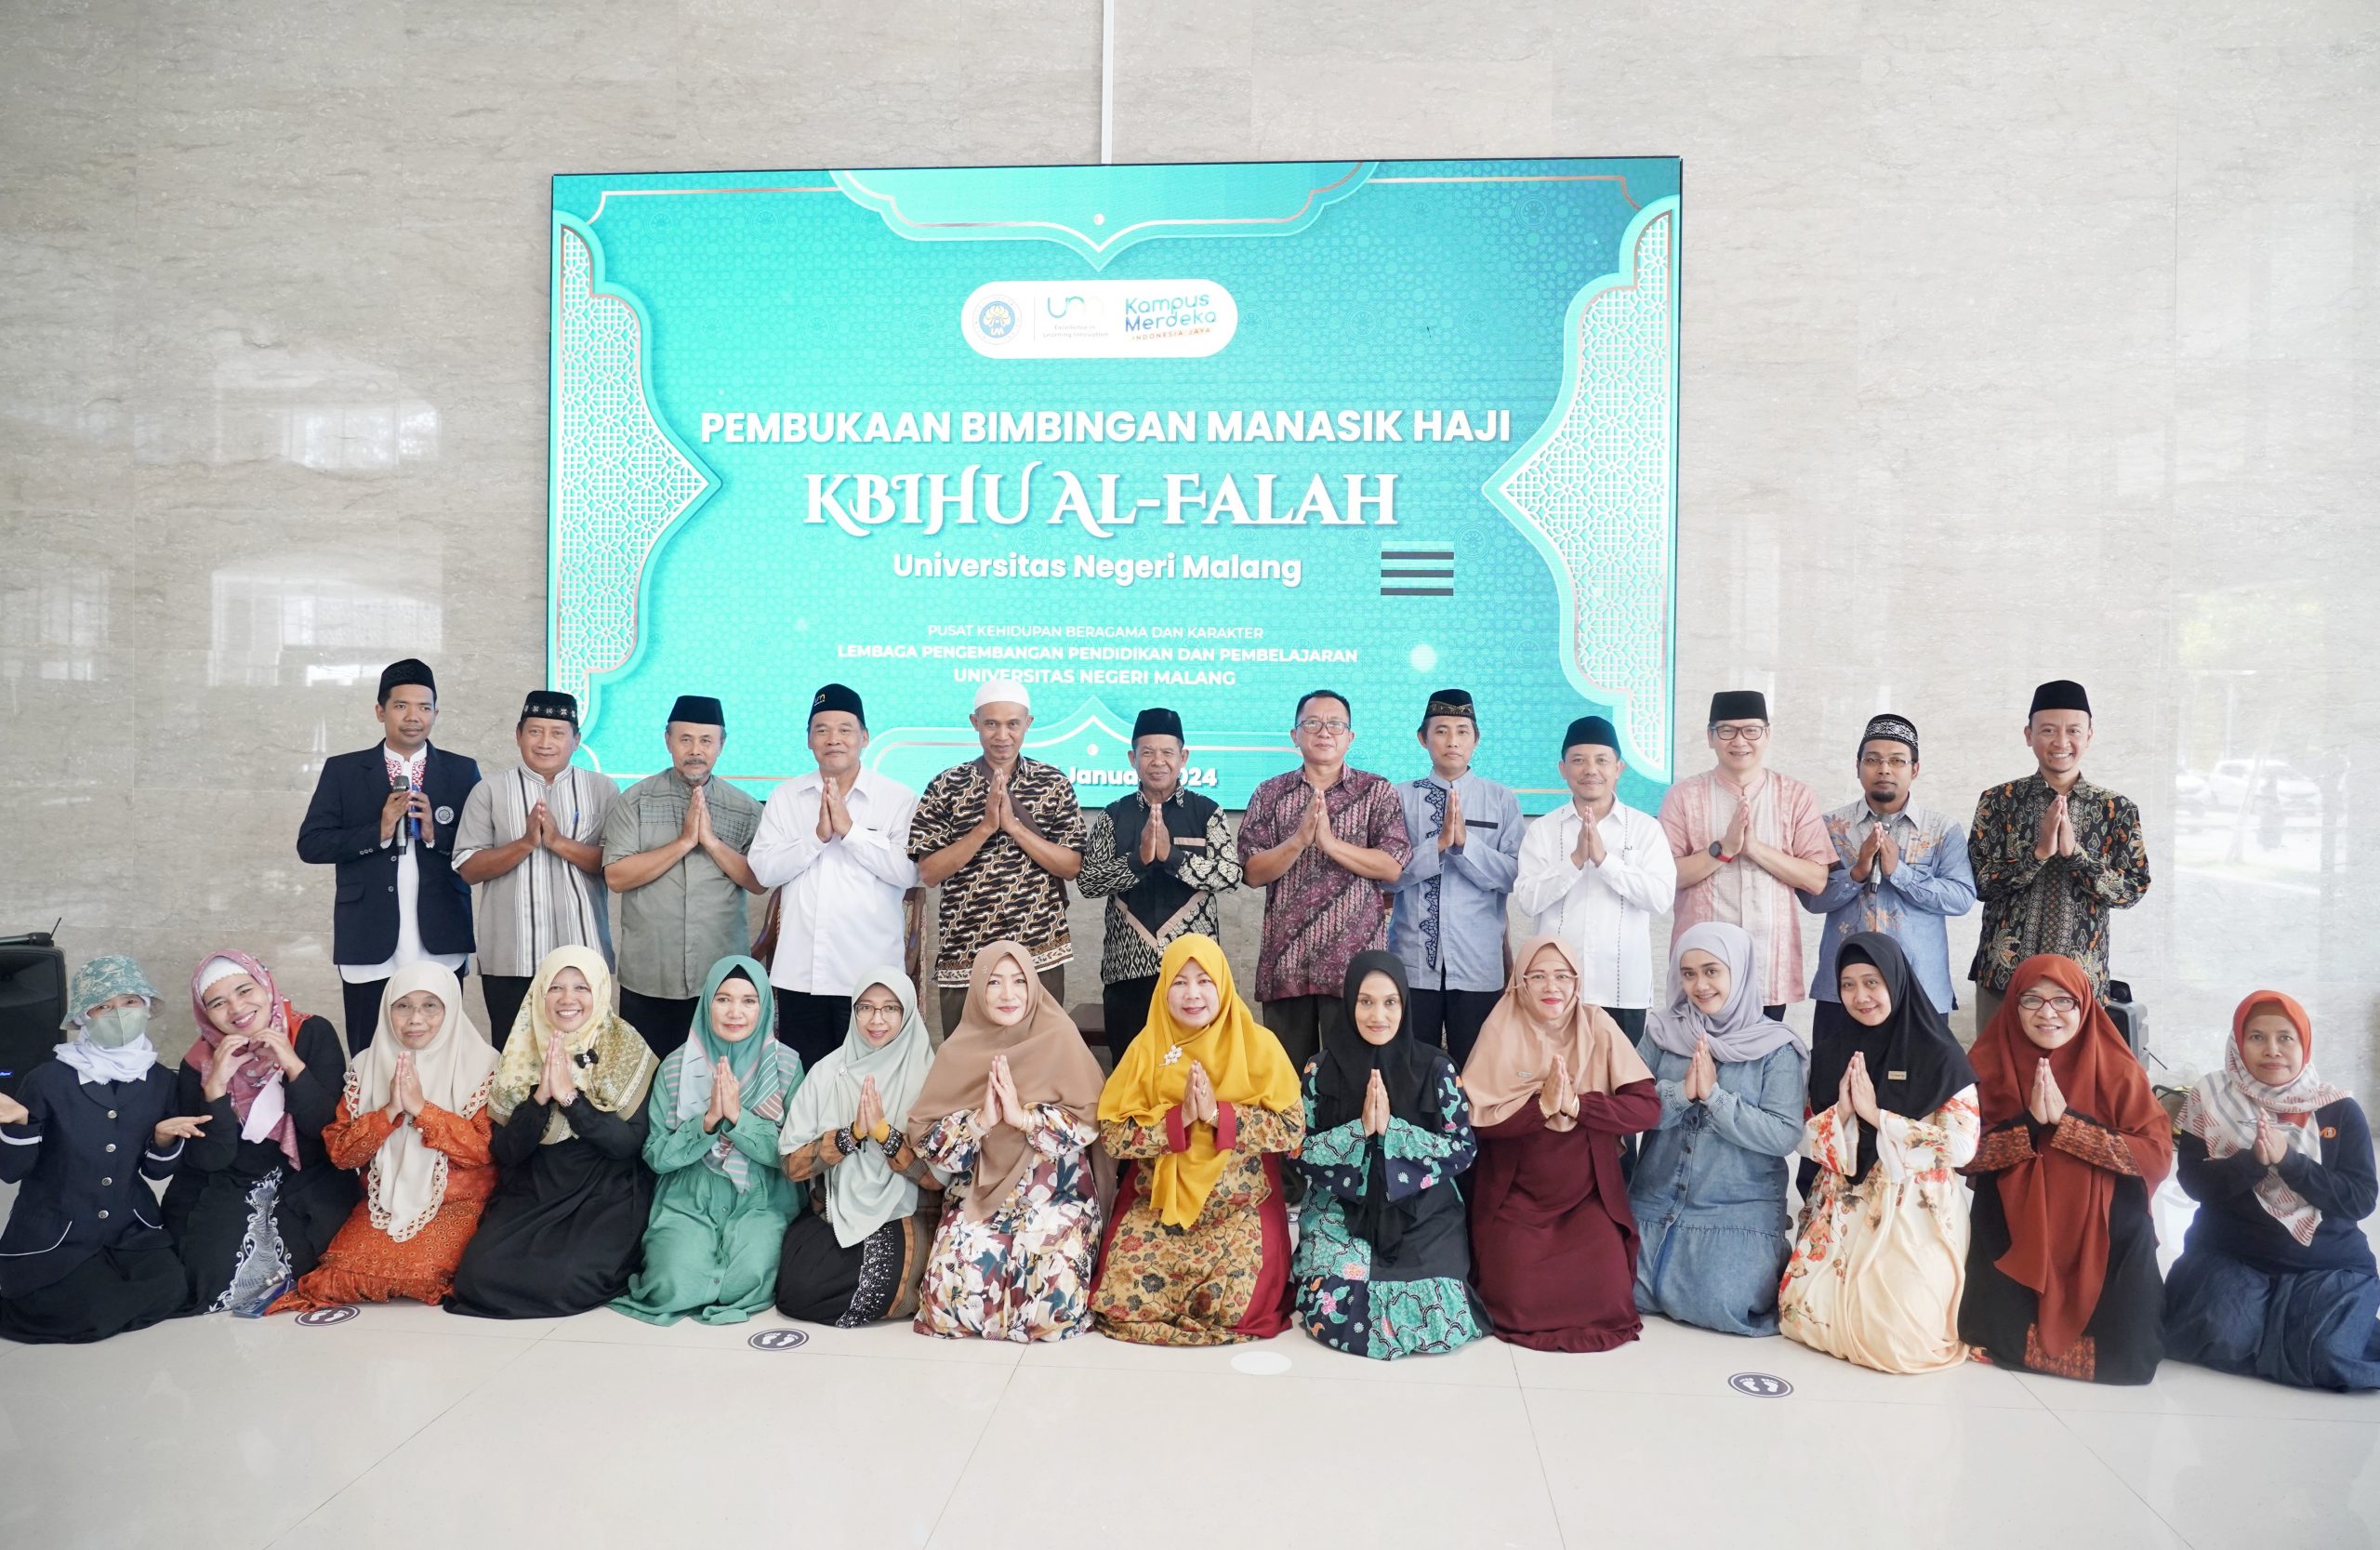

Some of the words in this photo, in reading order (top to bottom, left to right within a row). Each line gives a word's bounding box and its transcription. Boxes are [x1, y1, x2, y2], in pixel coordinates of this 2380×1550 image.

[1125, 294, 1210, 315] Kampus
[1125, 309, 1217, 332] Merdeka
[1132, 330, 1183, 340] INDONESIA
[1188, 327, 1210, 336] JAYA
[701, 412, 951, 443] PEMBUKAAN
[961, 411, 1197, 443] BIMBINGAN
[1208, 410, 1402, 442] MANASIK
[1413, 410, 1511, 442] HAJI
[803, 460, 1043, 537] KBIHU
[1047, 469, 1398, 538] AL-FALAH
[893, 551, 1066, 578] Universitas
[1075, 551, 1175, 586] Negeri
[1183, 553, 1302, 587] Malang
[928, 624, 973, 637] PUSAT
[977, 625, 1062, 638] KEHIDUPAN
[1065, 626, 1146, 638] BERAGAMA
[1152, 627, 1183, 638] DAN
[1187, 627, 1263, 639] KARAKTER
[838, 645, 919, 658] LEMBAGA
[922, 645, 1064, 660] PENGEMBANGAN
[1068, 647, 1172, 660] PENDIDIKAN
[1178, 648, 1214, 661] DAN
[1220, 648, 1357, 662] PEMBELAJARAN
[954, 668, 1075, 683] UNIVERSITAS
[1080, 669, 1148, 683] NEGERI
[1155, 669, 1236, 685] MALANG
[1069, 765, 1140, 786] Janua
[1178, 766, 1218, 787] 024
